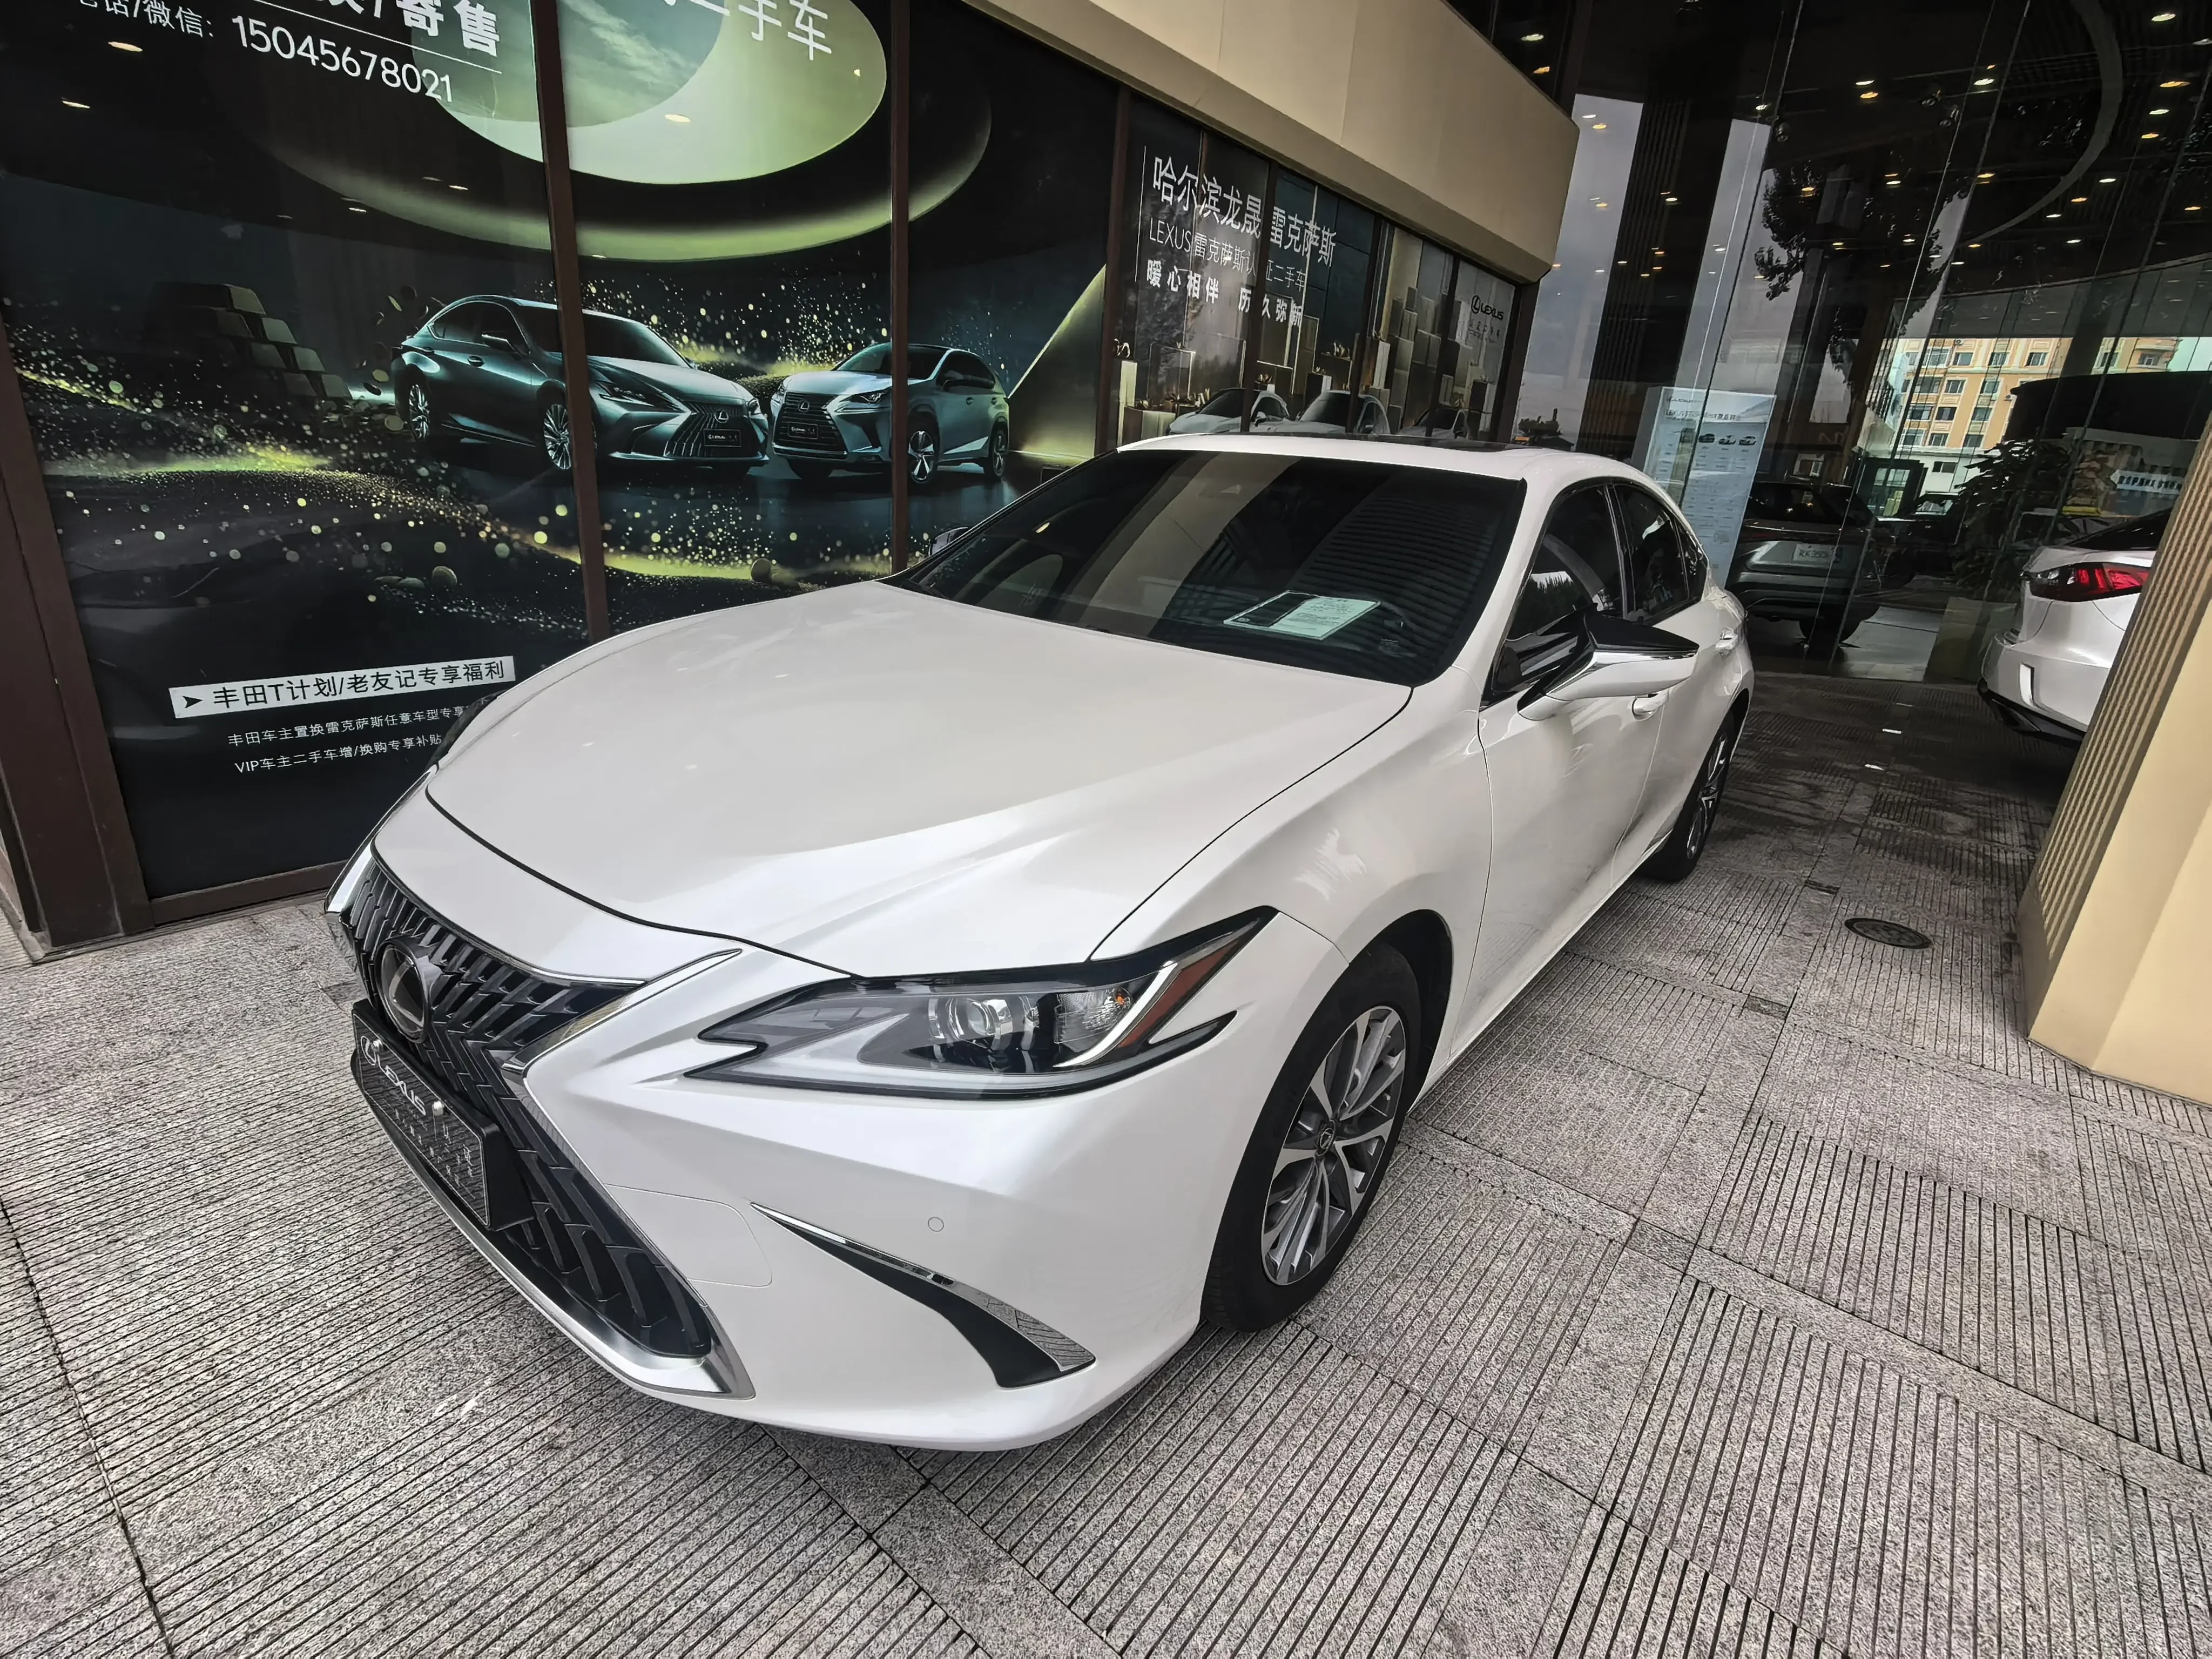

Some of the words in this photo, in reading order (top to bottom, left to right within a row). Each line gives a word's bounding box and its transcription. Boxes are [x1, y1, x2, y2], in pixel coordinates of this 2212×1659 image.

[232, 16, 452, 103] 15045678021
[1149, 217, 1191, 252] LEXUS
[1153, 156, 1262, 239] 哈尔滨龙晟
[1270, 206, 1337, 267] 雷克萨斯
[1147, 259, 1219, 304] 暖心相伴
[213, 660, 505, 709] 丰田T计划/老友记专享福利
[227, 706, 469, 746] 丰田车主置换雷克萨斯任意车型专享
[234, 733, 442, 773] VIP车主二手车增/换购专享补贴
[377, 1054, 427, 1116] LEXUS
